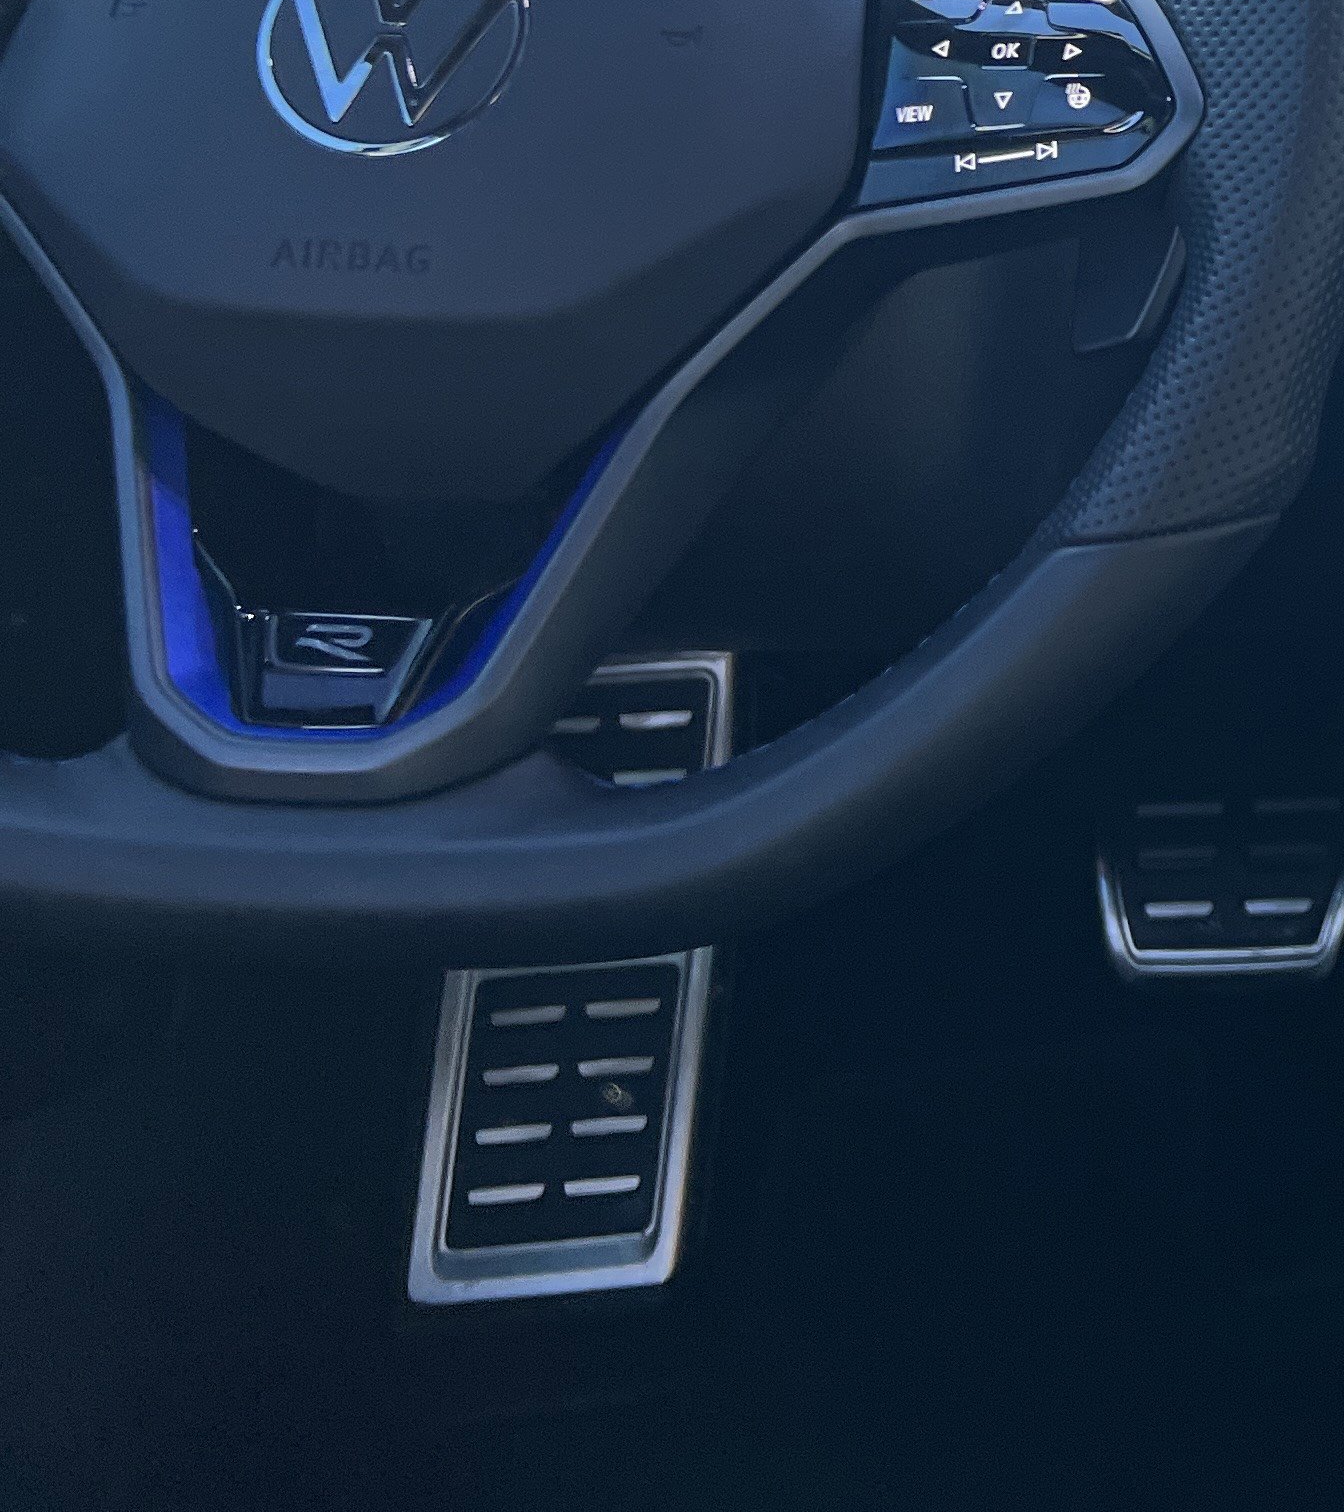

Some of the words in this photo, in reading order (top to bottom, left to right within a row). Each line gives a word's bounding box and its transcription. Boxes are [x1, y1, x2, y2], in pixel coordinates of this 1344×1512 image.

[990, 42, 1022, 59] OK
[895, 104, 934, 124] VIEW
[271, 239, 432, 276] AIRBAG
